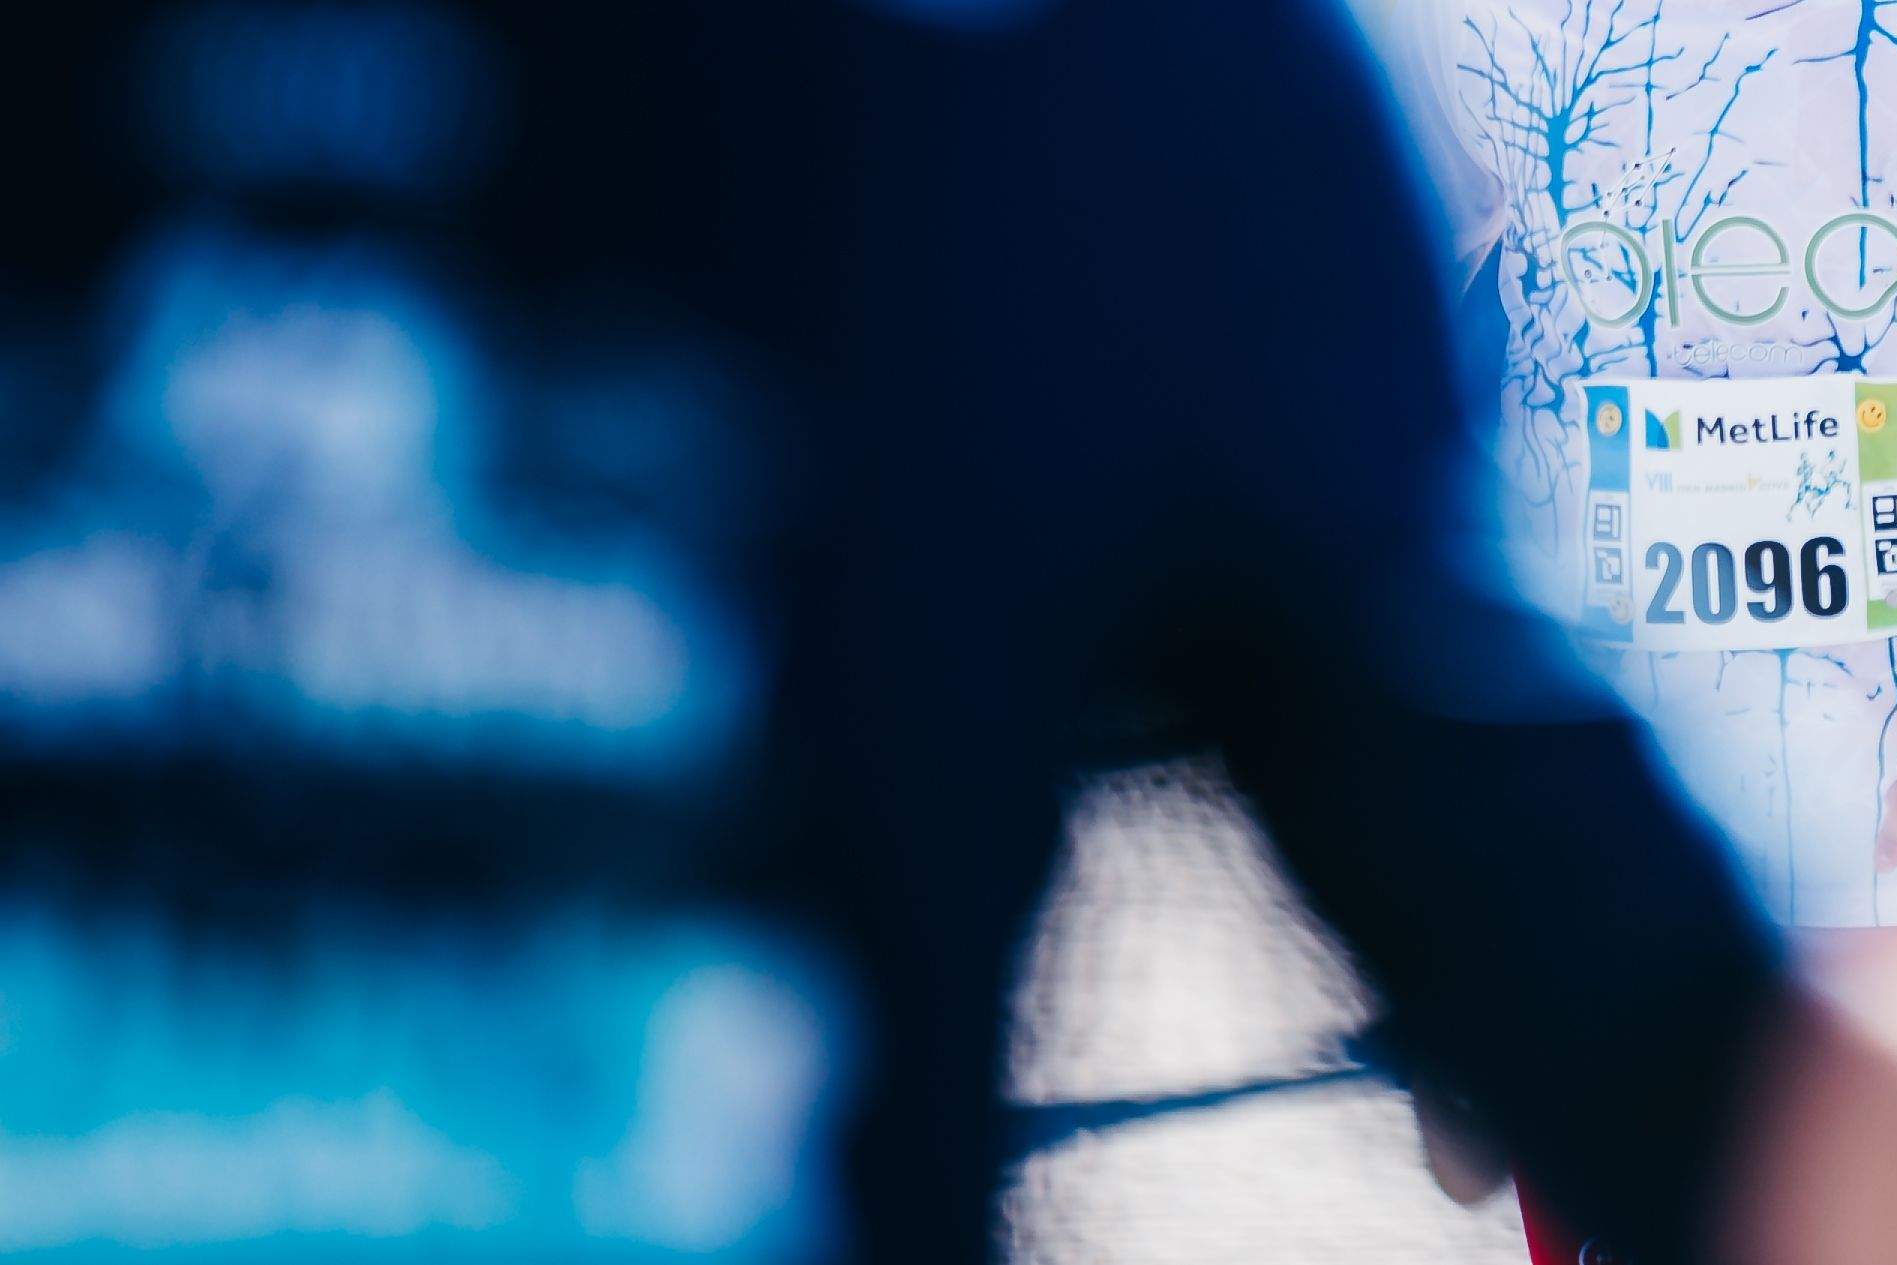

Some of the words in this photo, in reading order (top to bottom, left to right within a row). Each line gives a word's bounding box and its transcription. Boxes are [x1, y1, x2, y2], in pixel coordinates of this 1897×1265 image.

[1673, 336, 1805, 366] telecom
[1696, 410, 1840, 446] MetLife
[1644, 536, 1850, 626] 2096
